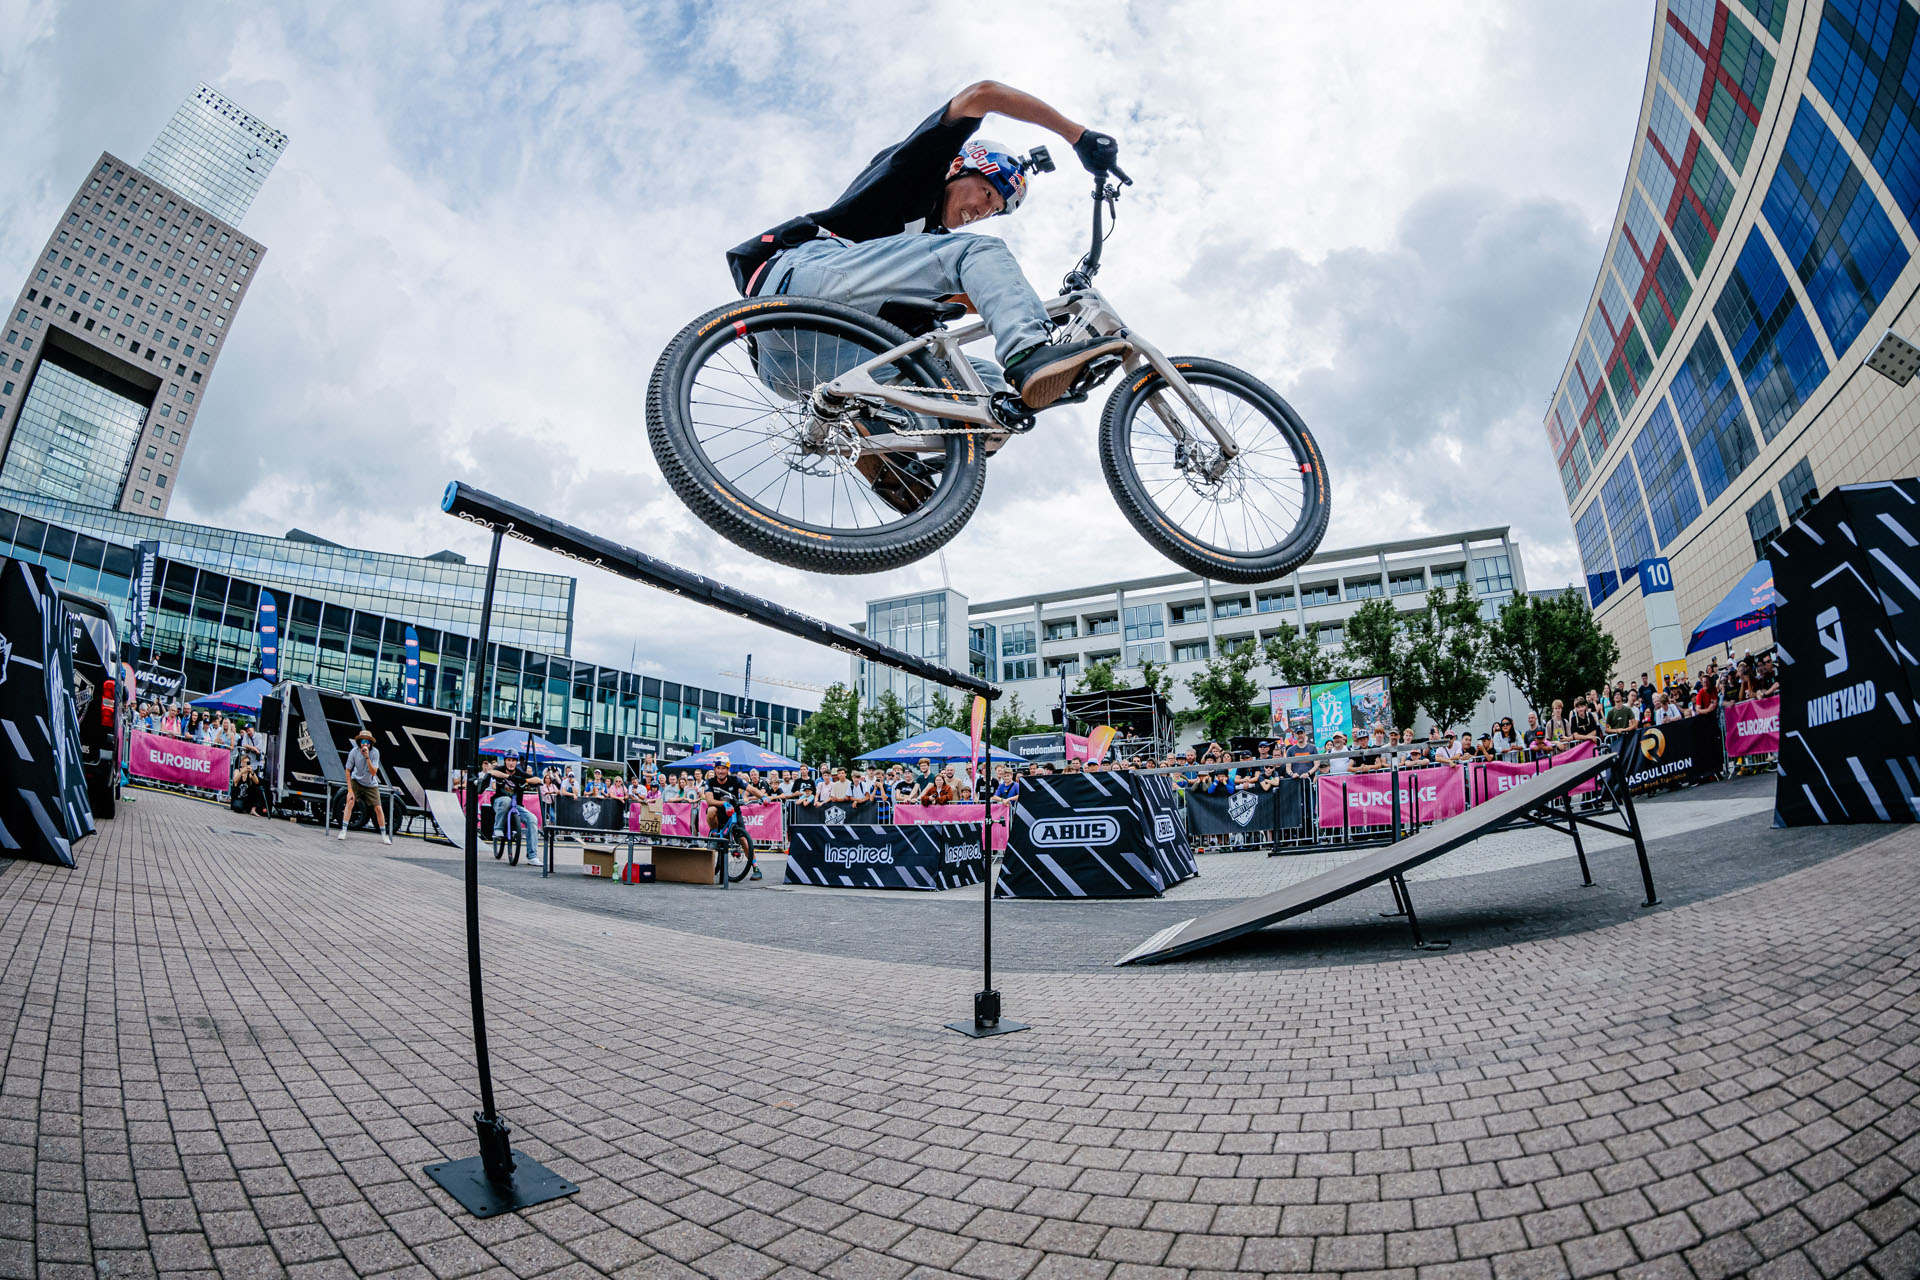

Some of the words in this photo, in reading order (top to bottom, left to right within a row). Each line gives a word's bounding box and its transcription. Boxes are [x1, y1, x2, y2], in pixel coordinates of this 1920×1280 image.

[697, 300, 789, 337] CONTINENTAL
[711, 479, 833, 541] CONTINENTAL
[1647, 563, 1669, 587] 10
[1807, 680, 1876, 728] NINEYARD
[1736, 715, 1780, 737] EUROBIKE
[149, 749, 211, 774] EUROBIKE
[1019, 744, 1066, 756] freedombmx
[1625, 757, 1692, 786] ASOULUTION
[1041, 823, 1107, 841] ABUS
[1158, 820, 1173, 836] ABUS
[825, 843, 894, 868] Inspired.
[945, 839, 982, 867] Inspired.
